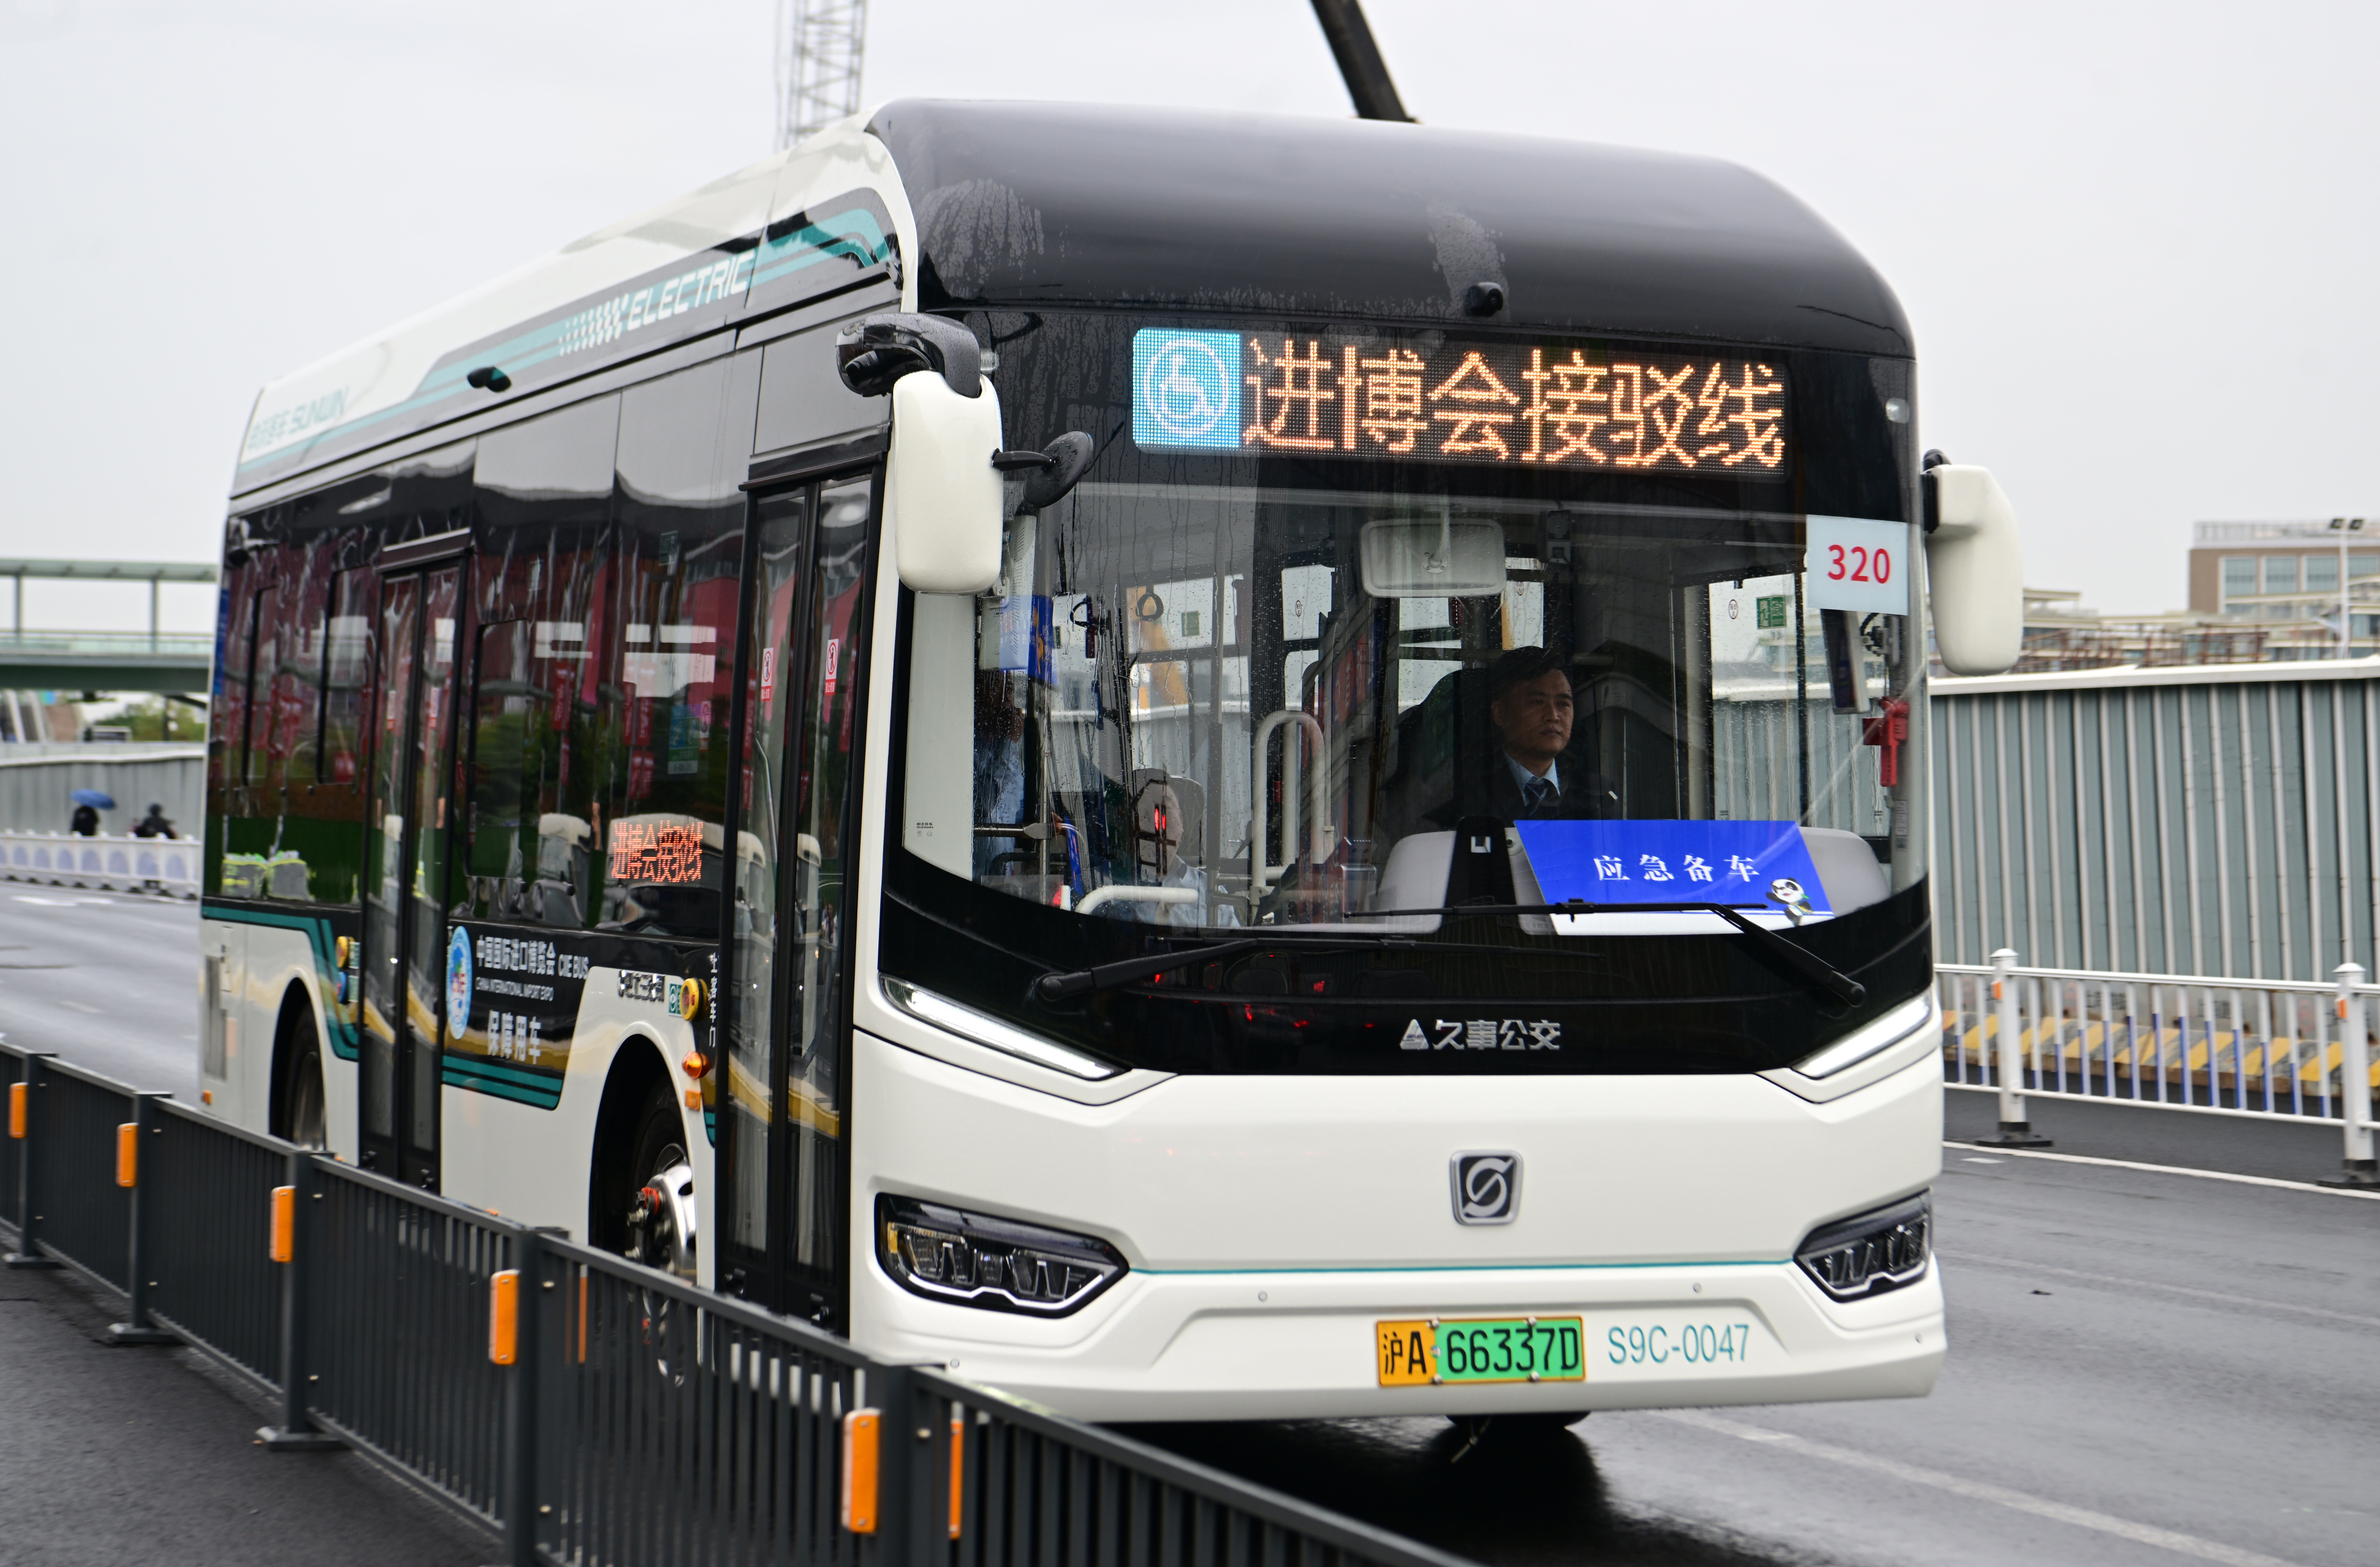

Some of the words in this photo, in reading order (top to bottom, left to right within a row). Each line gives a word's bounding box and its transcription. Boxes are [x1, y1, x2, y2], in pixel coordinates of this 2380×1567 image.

[627, 249, 755, 331] ELECTRIC
[1245, 338, 1785, 469] 进博会接驳线
[1827, 544, 1891, 585] 320
[1593, 853, 1761, 883] 应急备车
[476, 934, 556, 976] 中国国际进口博览会
[573, 955, 589, 980] BUS
[487, 1009, 542, 1065] 保障用车
[1432, 1019, 1561, 1050] 久事公交
[1383, 1330, 1428, 1375] 沪A
[1446, 1327, 1580, 1374] 66337D
[1607, 1323, 1749, 1365] S9C-0047
